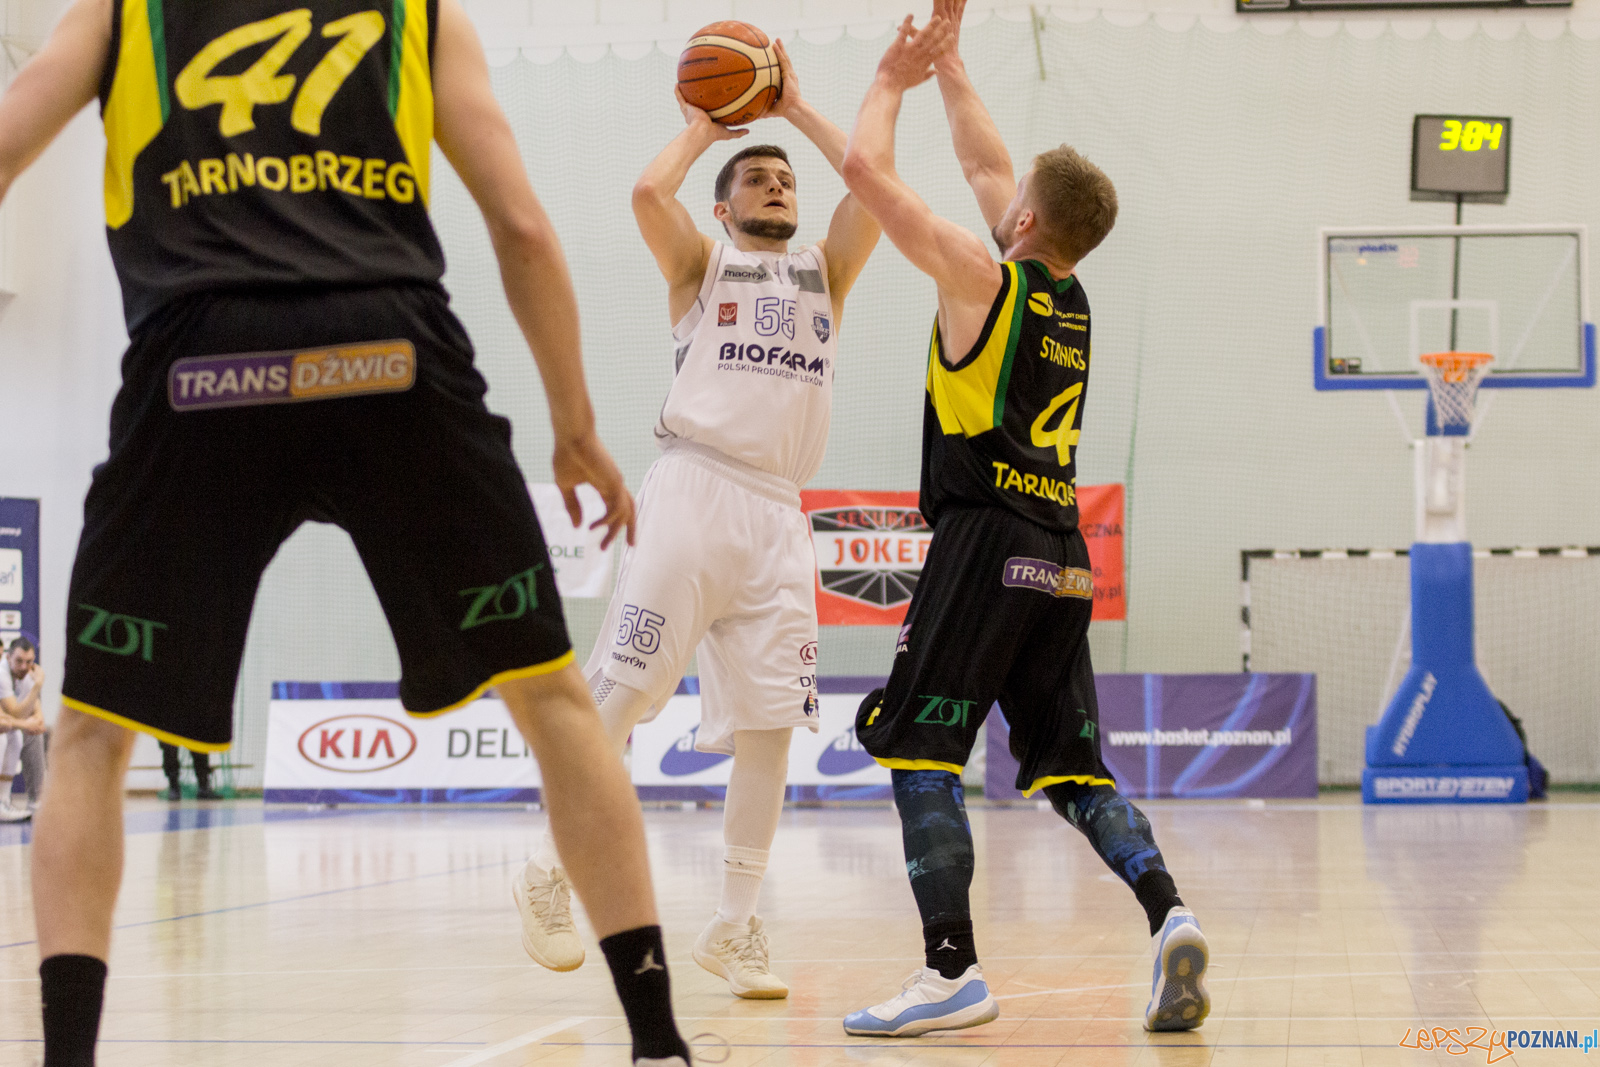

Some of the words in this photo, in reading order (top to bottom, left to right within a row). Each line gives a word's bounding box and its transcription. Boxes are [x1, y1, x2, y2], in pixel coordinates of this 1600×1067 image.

[174, 8, 386, 137] 41
[161, 150, 415, 209] TARNOBRZEG
[176, 363, 290, 400] TRANS
[296, 352, 409, 391] DŹWIG
[717, 362, 750, 372] POLSKI
[718, 342, 824, 377] BIOFARM
[1030, 381, 1084, 467] 4
[457, 562, 545, 631] ZOT
[76, 603, 168, 662] ZOT
[615, 603, 666, 655] 55
[914, 694, 978, 729] ZOT
[318, 728, 397, 760] KIA
